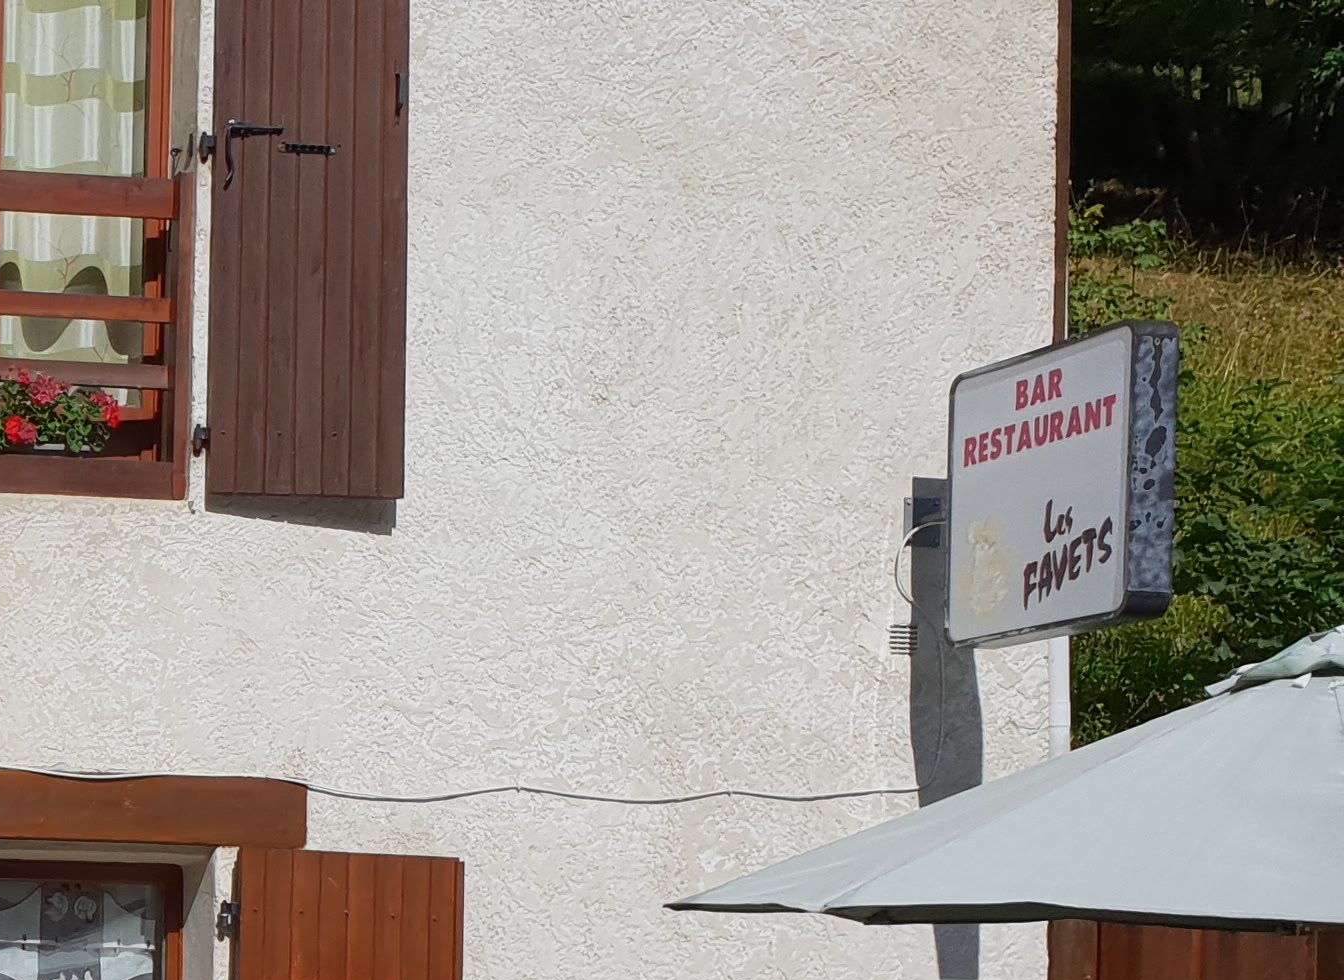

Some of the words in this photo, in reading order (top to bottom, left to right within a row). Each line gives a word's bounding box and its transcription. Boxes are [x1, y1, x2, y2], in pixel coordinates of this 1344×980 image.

[1015, 368, 1063, 411] BAR
[963, 394, 1116, 467] RESTAURANT
[1043, 499, 1073, 543] Les
[1023, 516, 1113, 611] FAVETS
